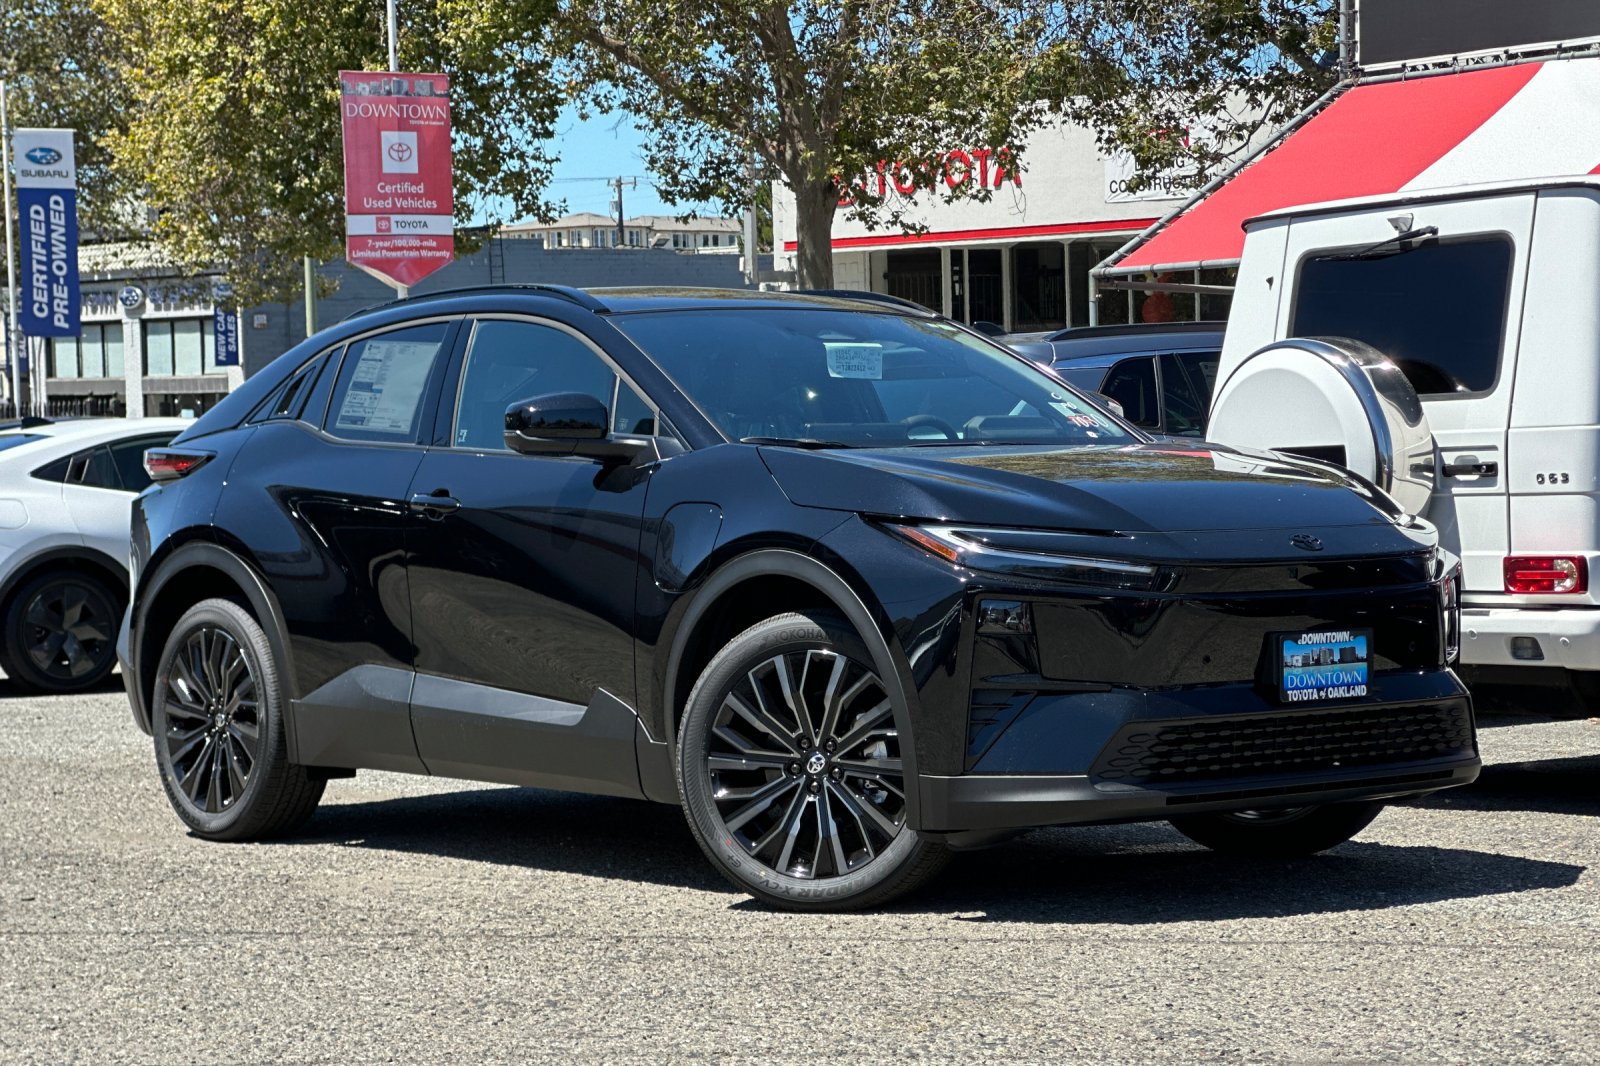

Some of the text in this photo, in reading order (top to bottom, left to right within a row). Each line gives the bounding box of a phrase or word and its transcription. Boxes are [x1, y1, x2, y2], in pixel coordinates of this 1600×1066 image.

[346, 103, 447, 119] DOWNTOWN
[21, 169, 69, 178] SUBARU
[377, 182, 424, 194] Certified
[364, 197, 437, 209] Used Vehicles
[394, 220, 429, 230] TOYOTA
[31, 204, 49, 318] CERTIFIED
[51, 194, 70, 329] PRE-OWNED
[352, 250, 450, 259] Limited Powertrain Warranty
[226, 315, 236, 352] SALES
[217, 334, 226, 361] NEW
[1301, 631, 1350, 645] DOWNTOWN
[1288, 671, 1362, 688] DOWNTOWN
[1288, 688, 1318, 701] TOYOTA
[1328, 685, 1367, 698] OAKLAND
